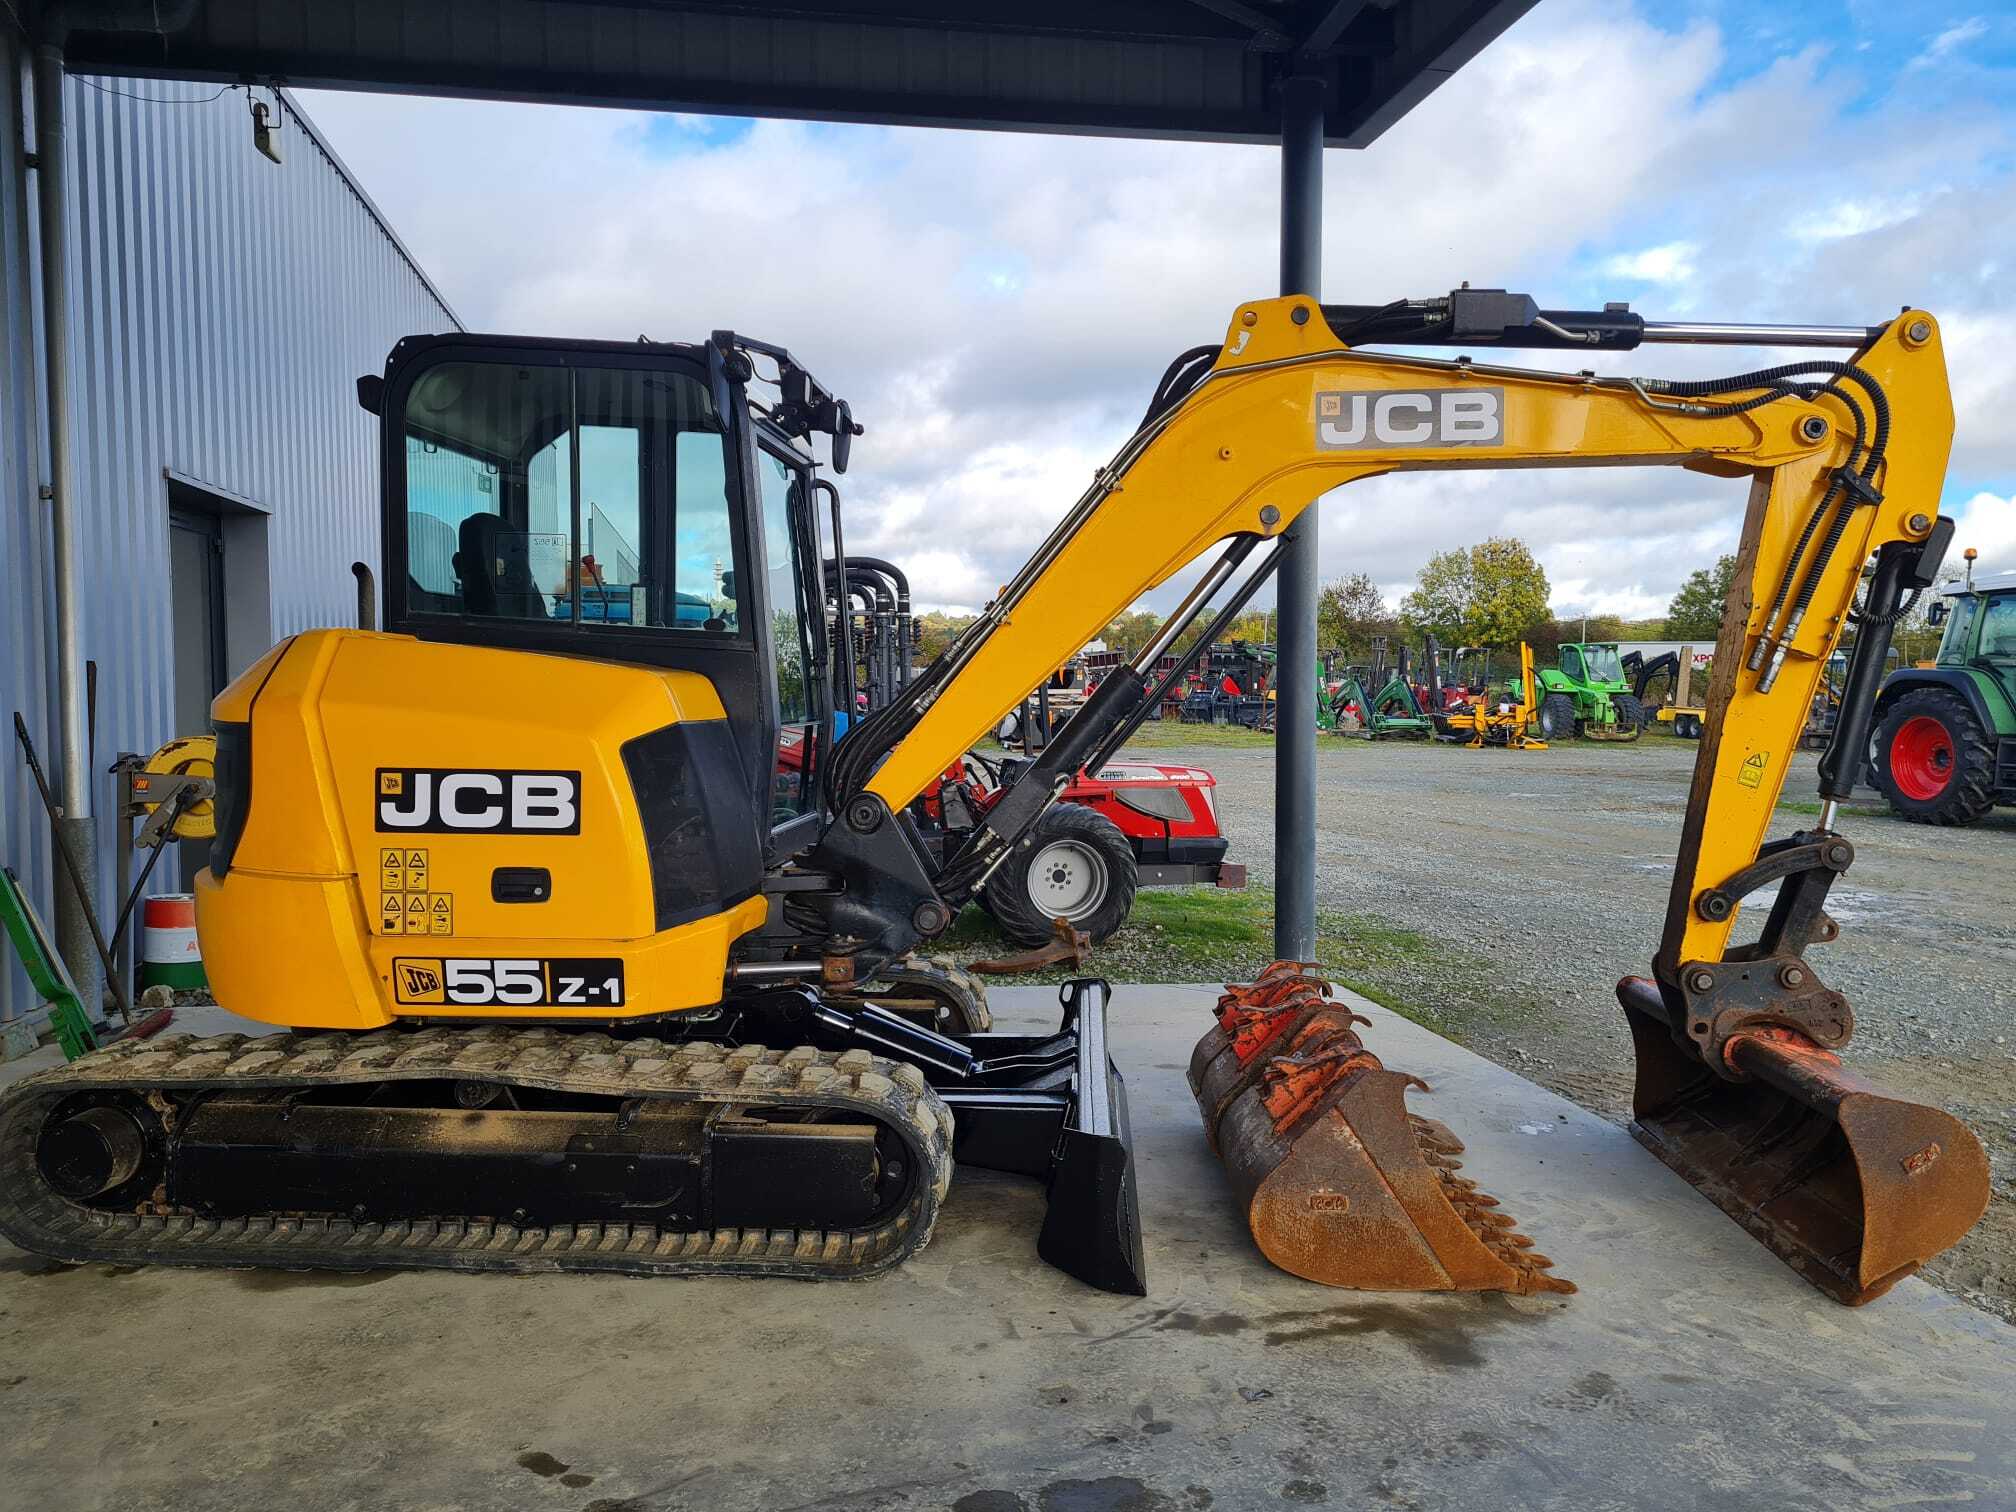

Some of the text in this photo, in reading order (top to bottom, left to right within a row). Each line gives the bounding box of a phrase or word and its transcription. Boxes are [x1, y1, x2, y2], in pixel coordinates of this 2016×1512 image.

[1320, 392, 1499, 445] JCB
[380, 773, 576, 829] JCB
[407, 968, 438, 993] JCB
[445, 959, 620, 1004] 55 Z-1
